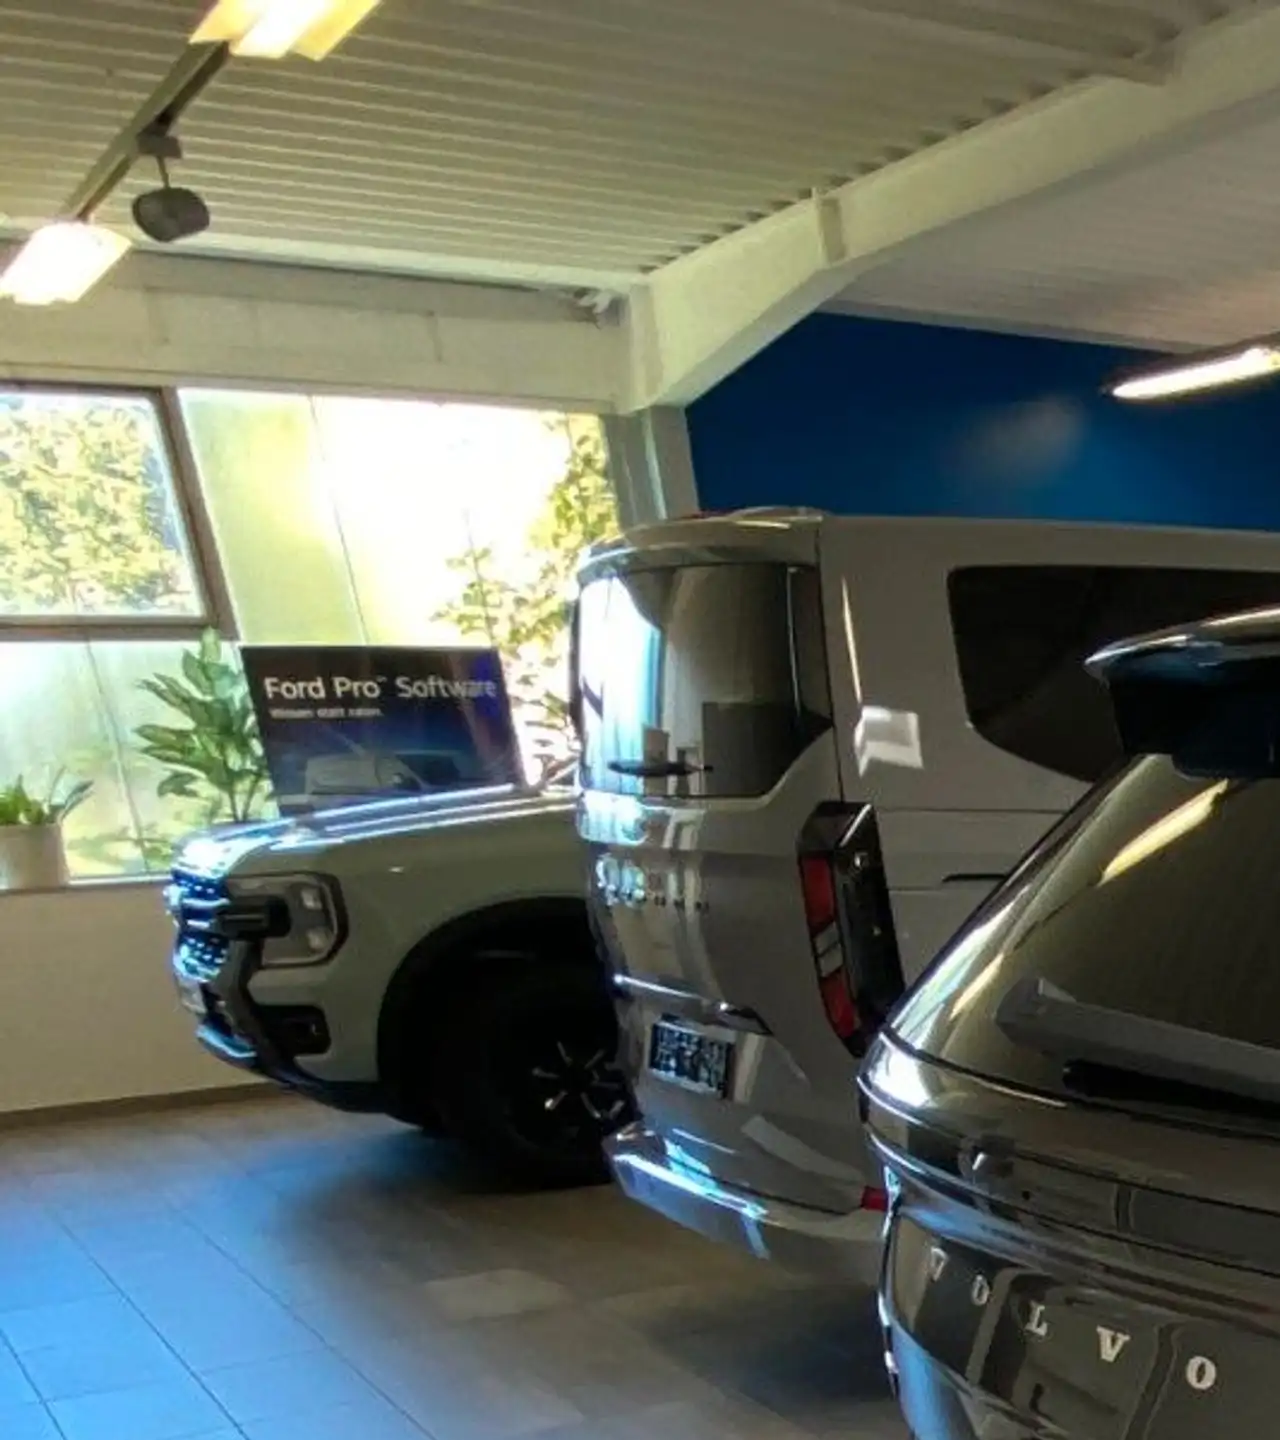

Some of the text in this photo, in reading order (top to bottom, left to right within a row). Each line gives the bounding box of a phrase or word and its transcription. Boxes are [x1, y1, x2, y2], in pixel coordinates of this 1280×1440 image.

[265, 676, 326, 698] Ford
[395, 675, 497, 698] Software
[930, 1247, 1217, 1390] VOLVO
